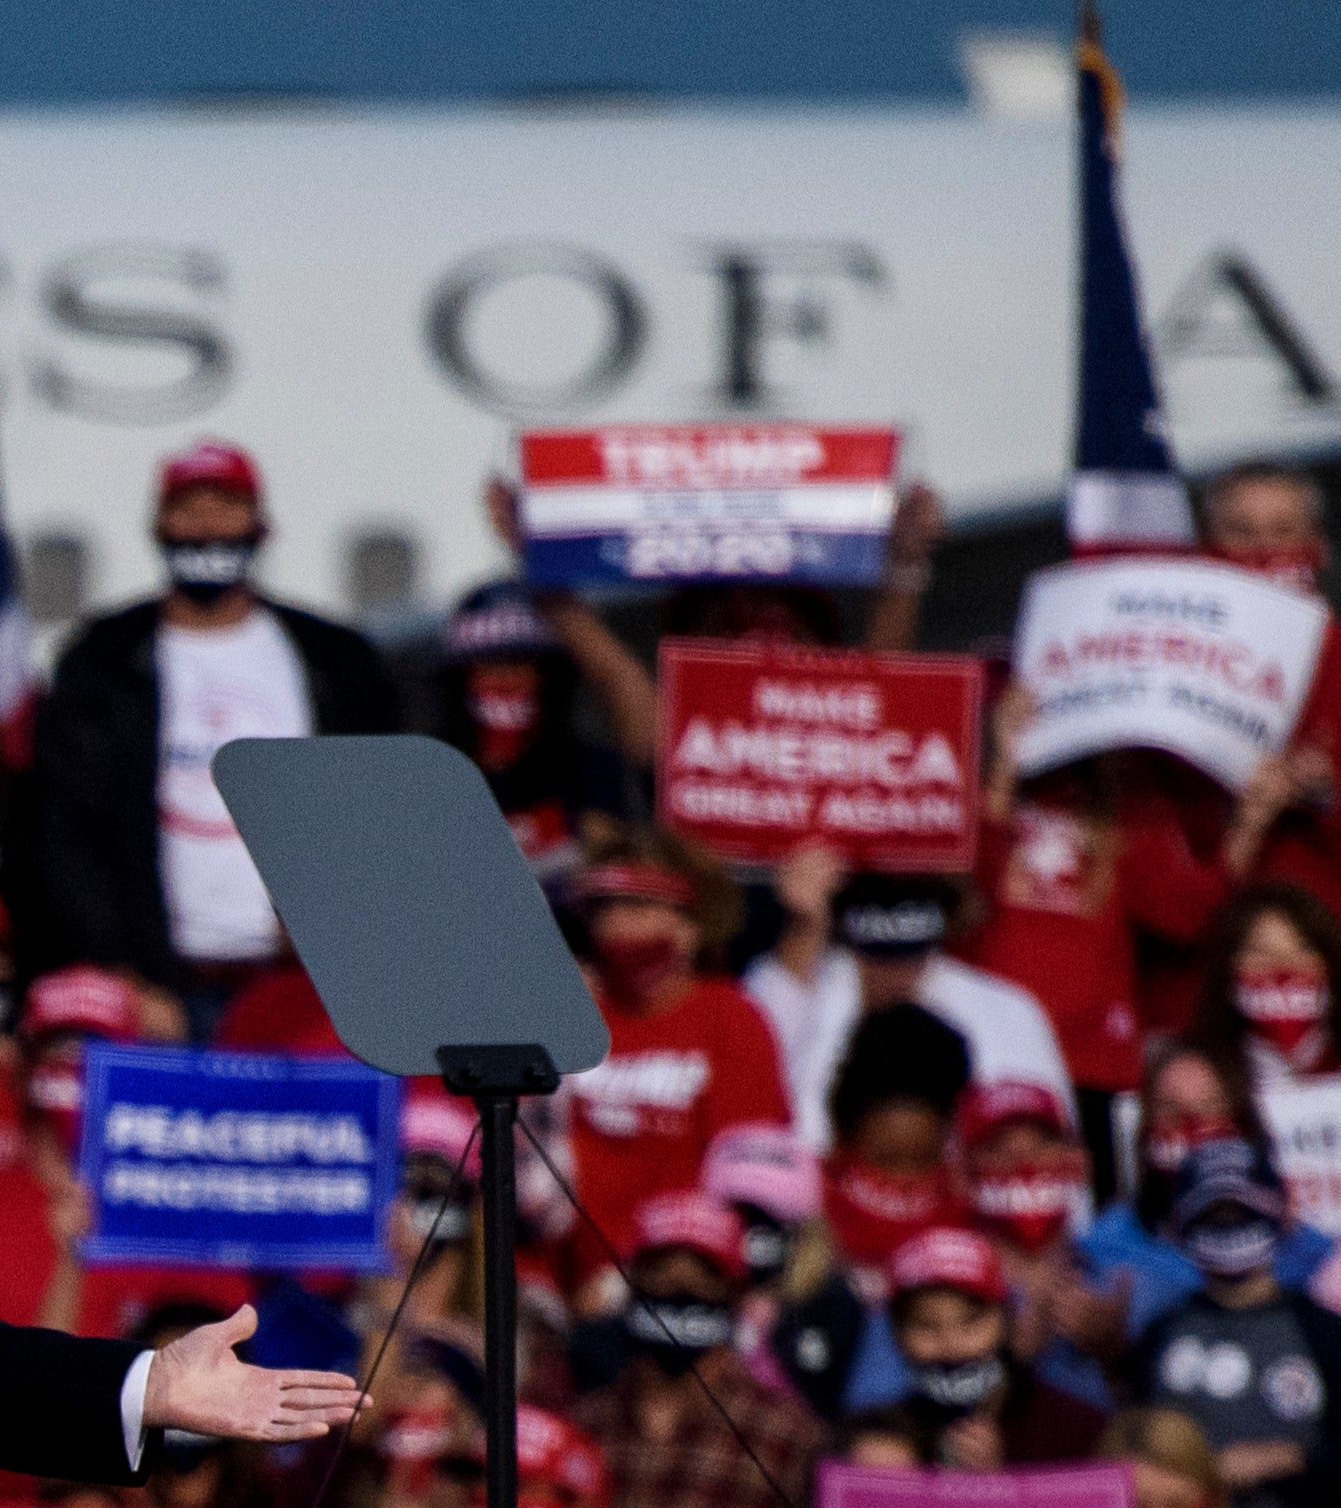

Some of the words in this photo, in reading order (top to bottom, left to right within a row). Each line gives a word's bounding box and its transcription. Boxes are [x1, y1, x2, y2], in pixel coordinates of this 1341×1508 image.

[421, 240, 891, 416] OF
[601, 430, 825, 487] TRUMP
[1040, 628, 1285, 701] AMERICA
[673, 714, 962, 784] AMERICA
[105, 1103, 369, 1162] PEACEFUL
[103, 1163, 368, 1214] PROTESTER
